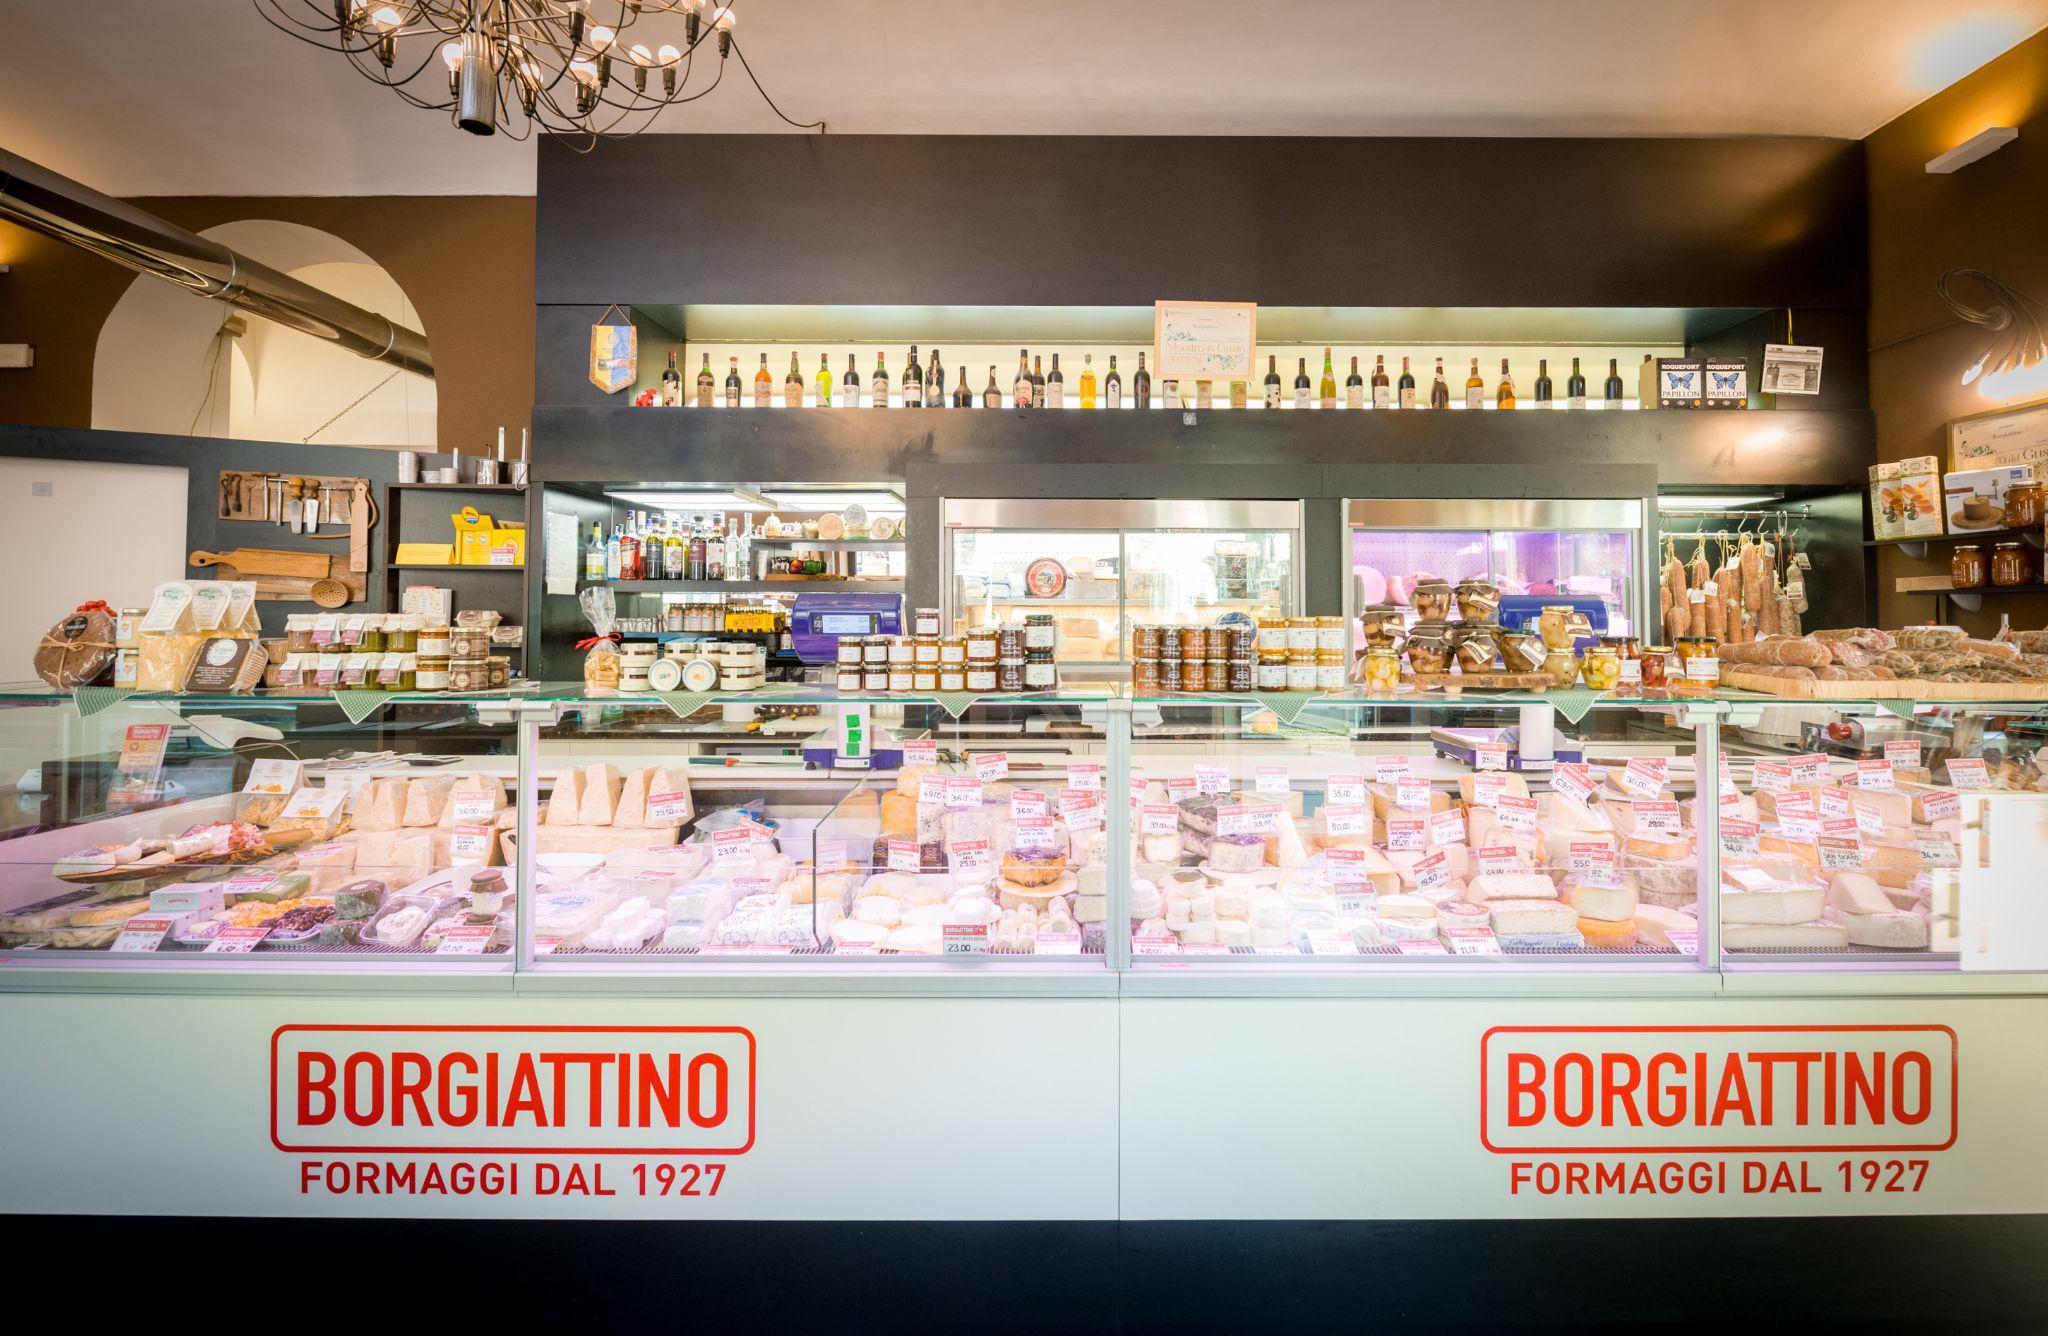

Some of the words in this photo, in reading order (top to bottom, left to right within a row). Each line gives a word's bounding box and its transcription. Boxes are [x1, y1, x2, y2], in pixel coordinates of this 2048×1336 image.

[298, 1051, 729, 1129] BORGIATTINO
[1507, 1050, 1933, 1128] BORGIATTINO
[302, 1162, 517, 1196] FORMAGGI
[535, 1162, 616, 1196] DAL
[633, 1162, 726, 1196] 1927
[1511, 1160, 1727, 1194] FORMAGGI
[1743, 1159, 1821, 1193] DAL
[1839, 1159, 1930, 1193] 1927
